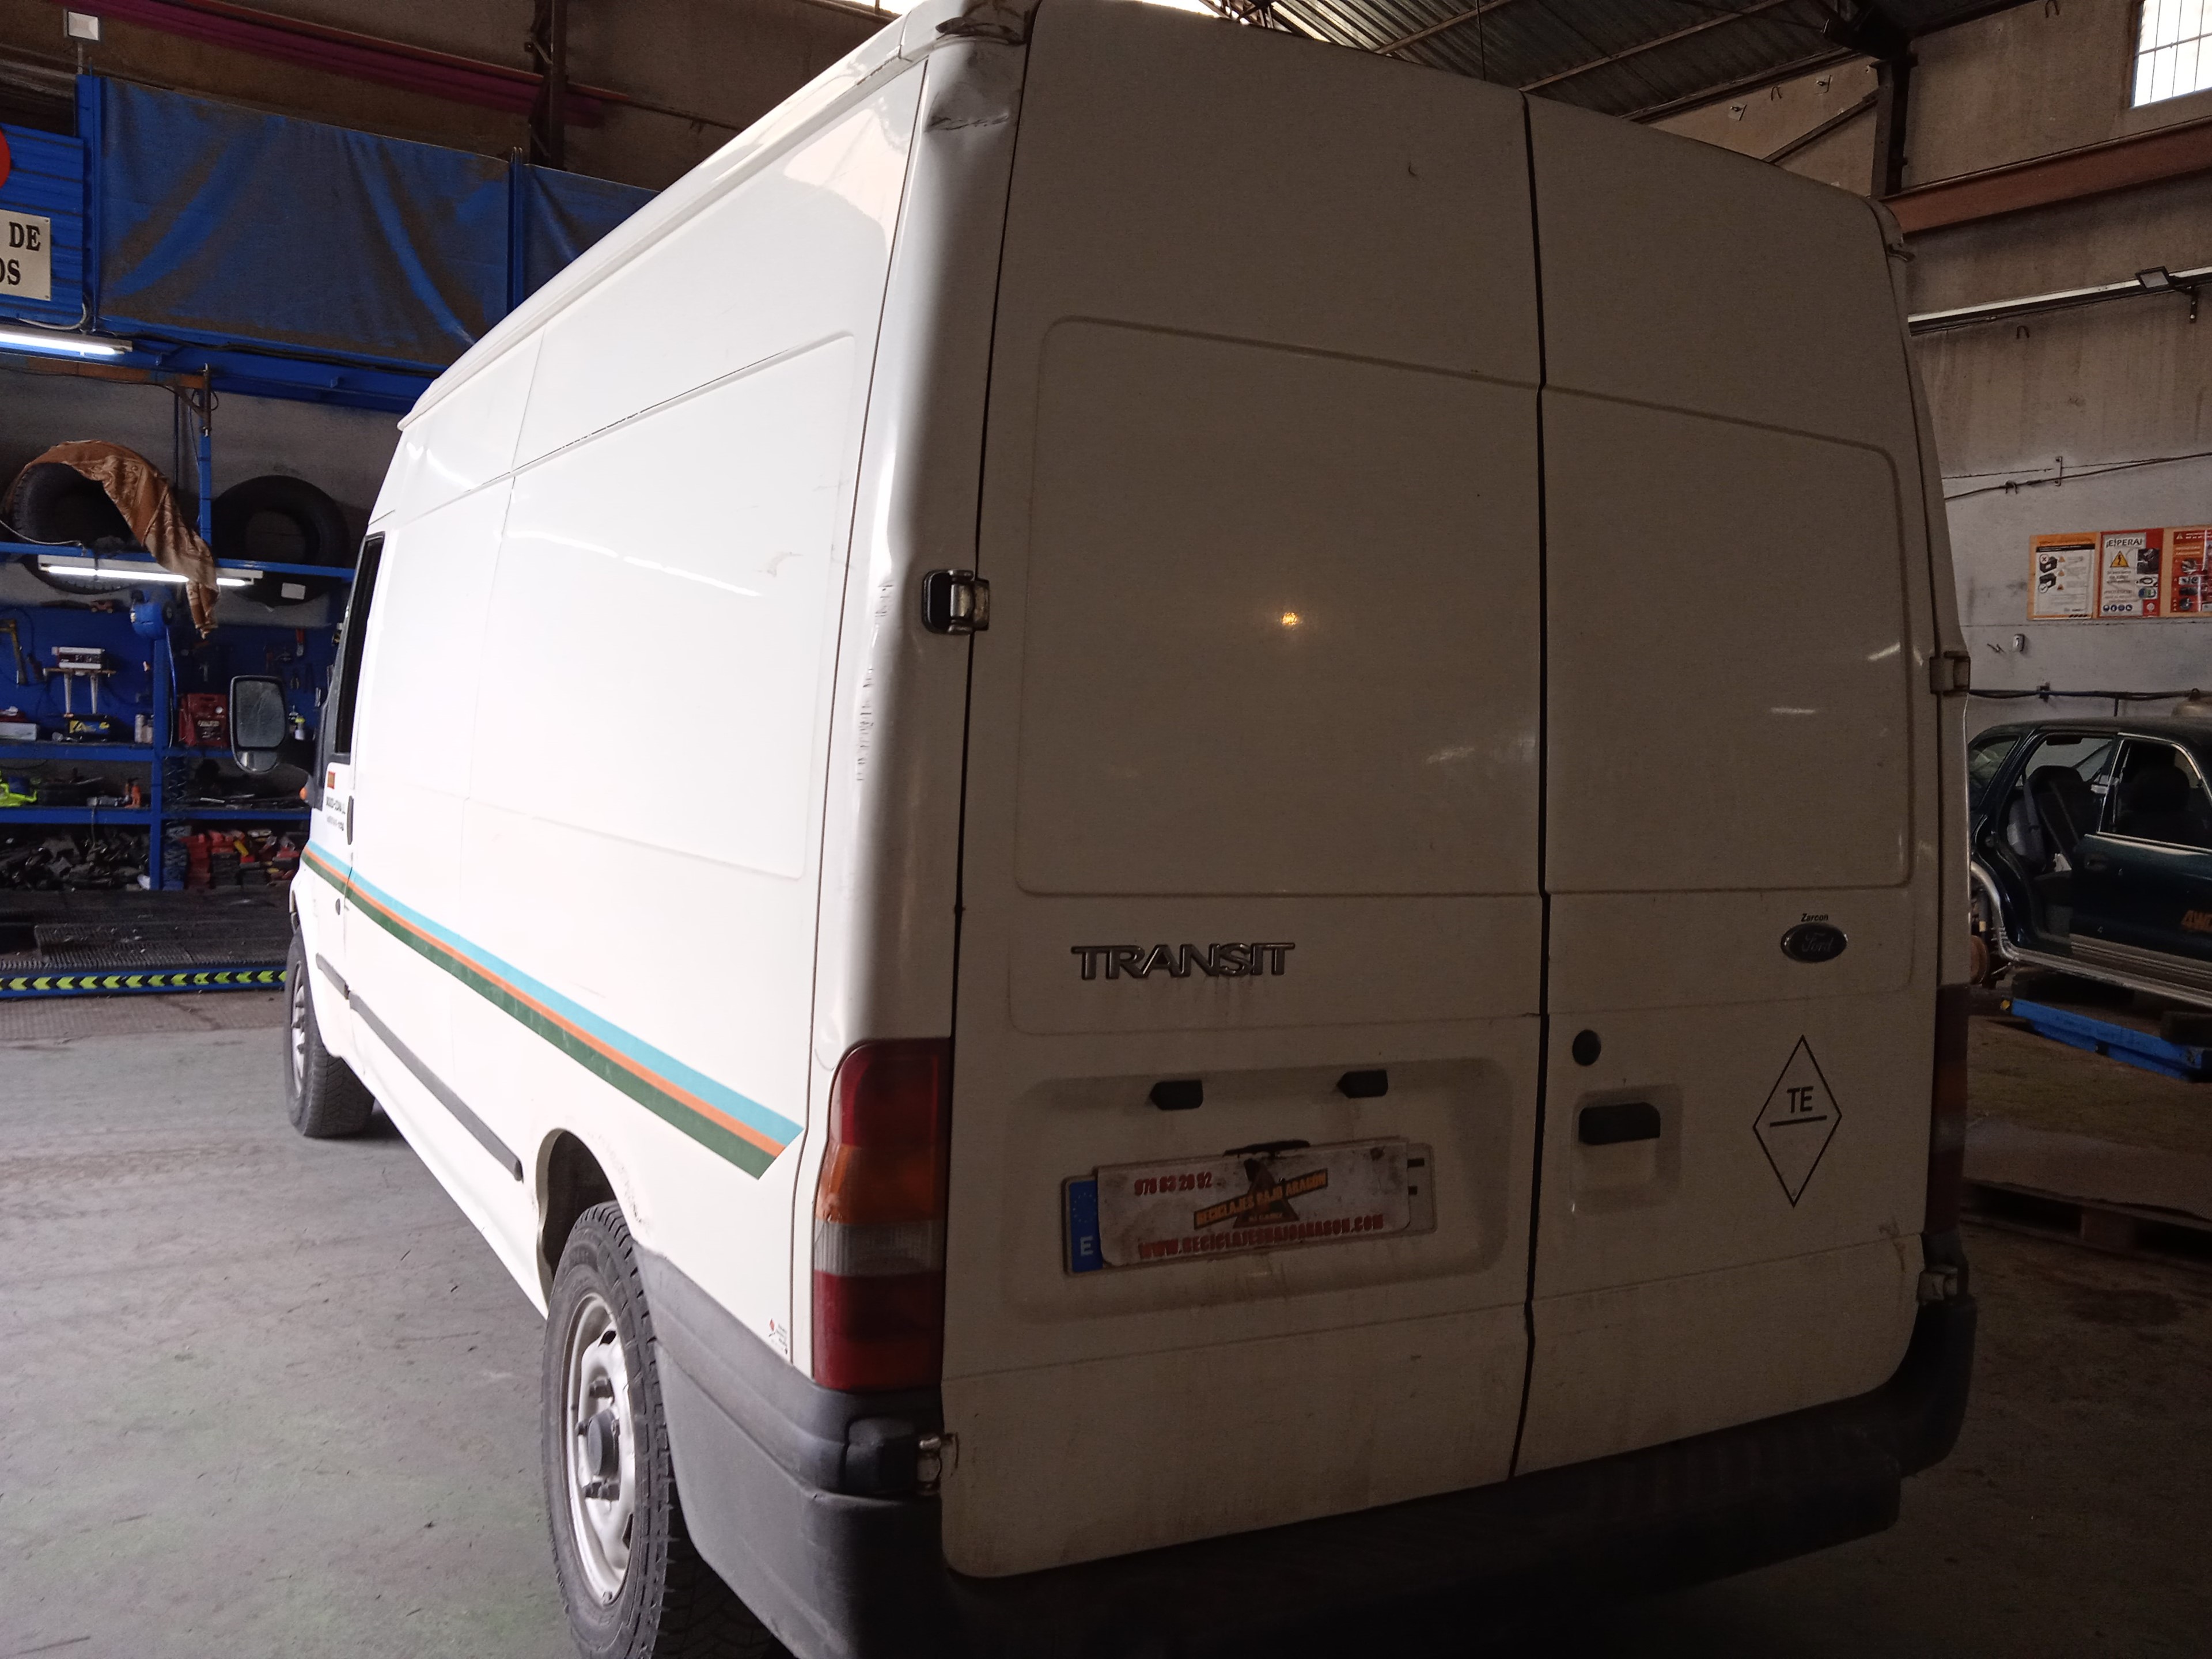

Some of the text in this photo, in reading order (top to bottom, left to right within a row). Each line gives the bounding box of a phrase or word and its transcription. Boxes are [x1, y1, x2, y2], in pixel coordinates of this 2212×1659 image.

[9, 221, 41, 252] DE
[1801, 913, 1829, 922] Zarcon
[1801, 932, 1834, 953] Ford
[1070, 942, 1296, 980] TRANSIT
[1787, 1085, 1814, 1113] TE
[1080, 1235, 1093, 1257] E
